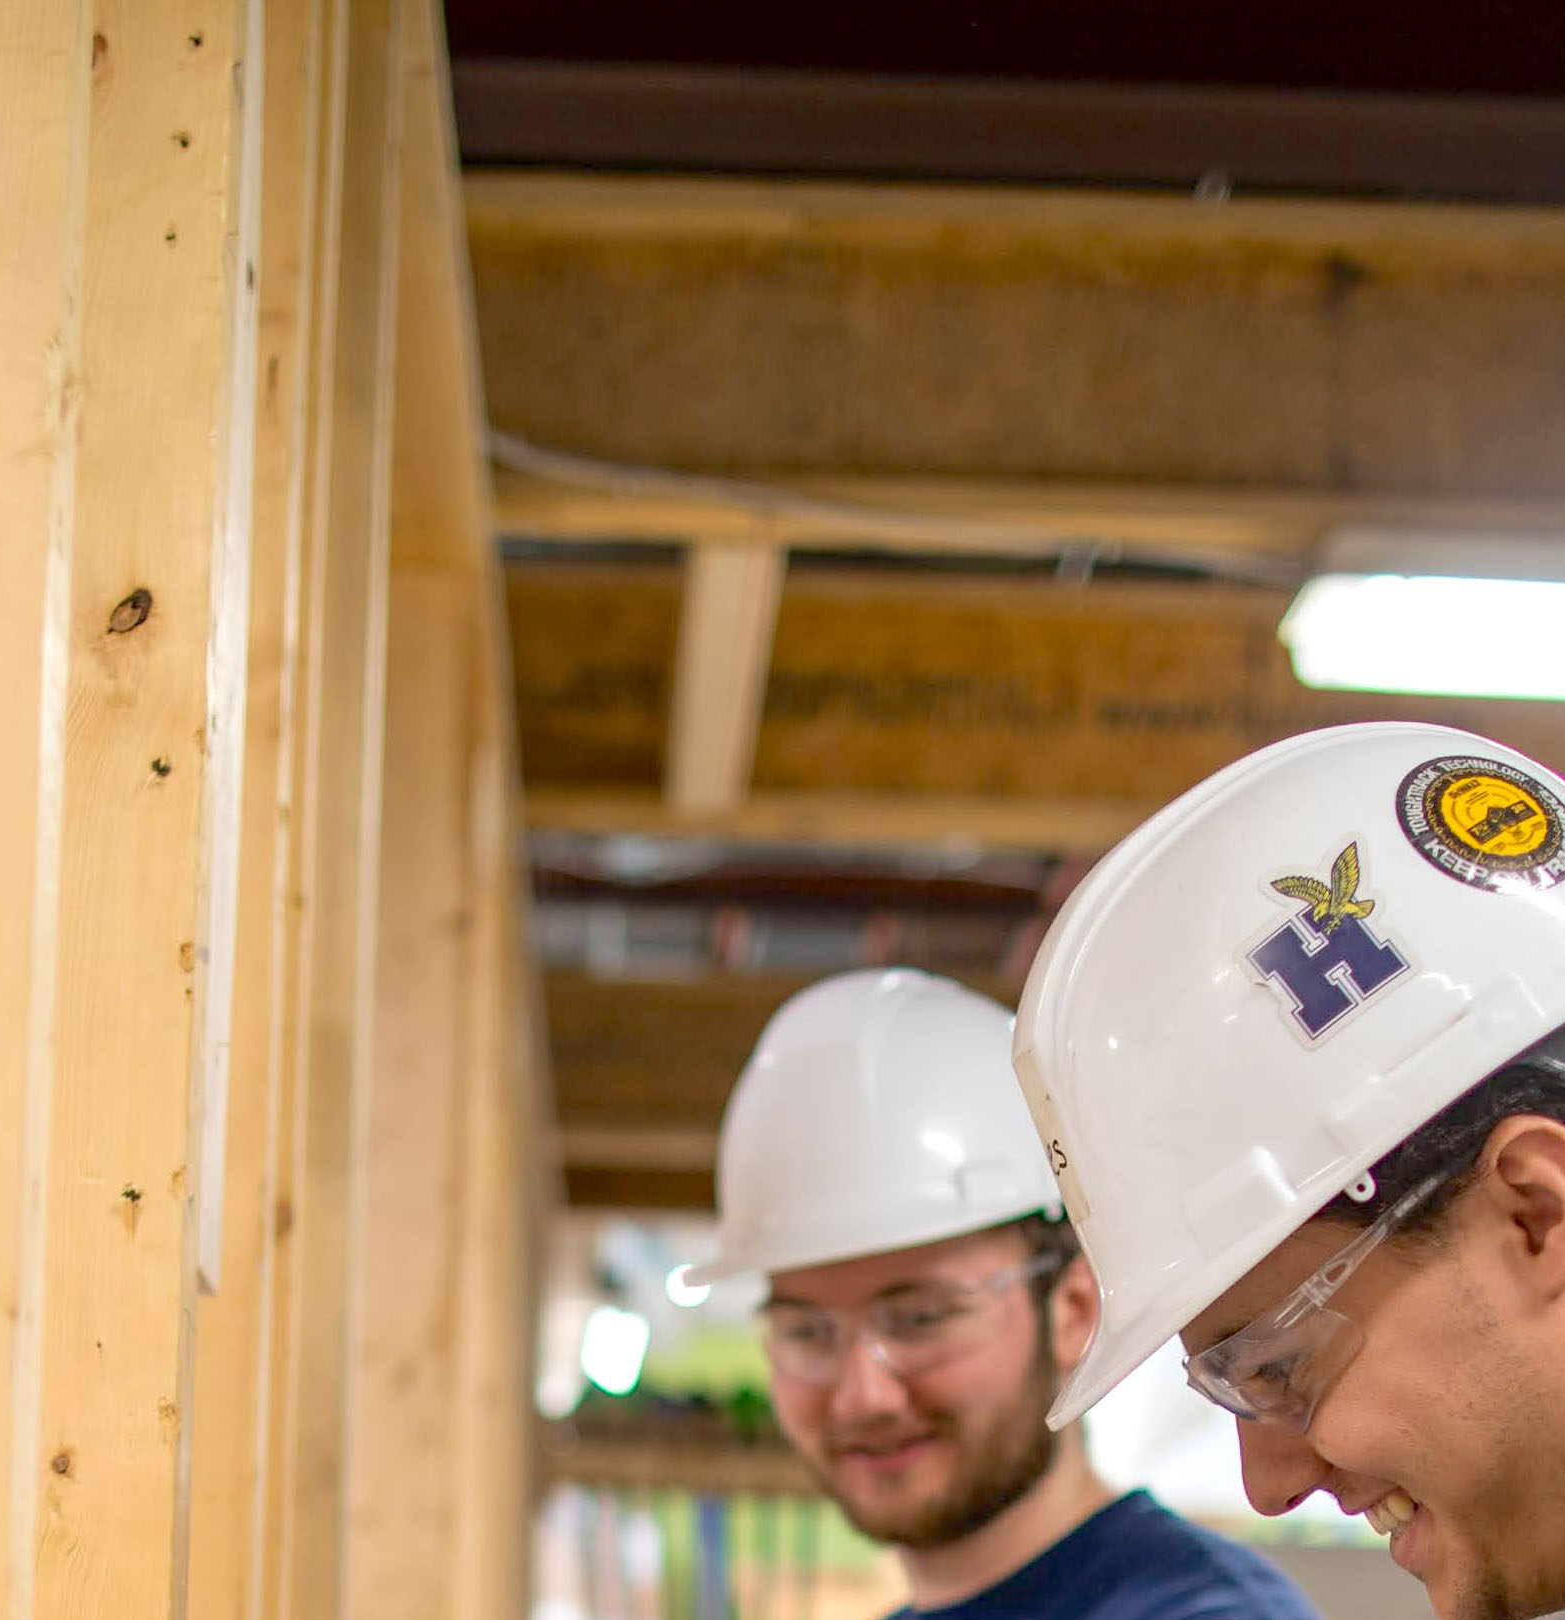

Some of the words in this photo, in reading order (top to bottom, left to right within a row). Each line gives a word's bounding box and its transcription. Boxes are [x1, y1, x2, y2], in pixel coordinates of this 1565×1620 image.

[1437, 759, 1531, 783] TECHNOLOGY
[1424, 838, 1489, 881] KEEP
[1247, 898, 1410, 1040] H
